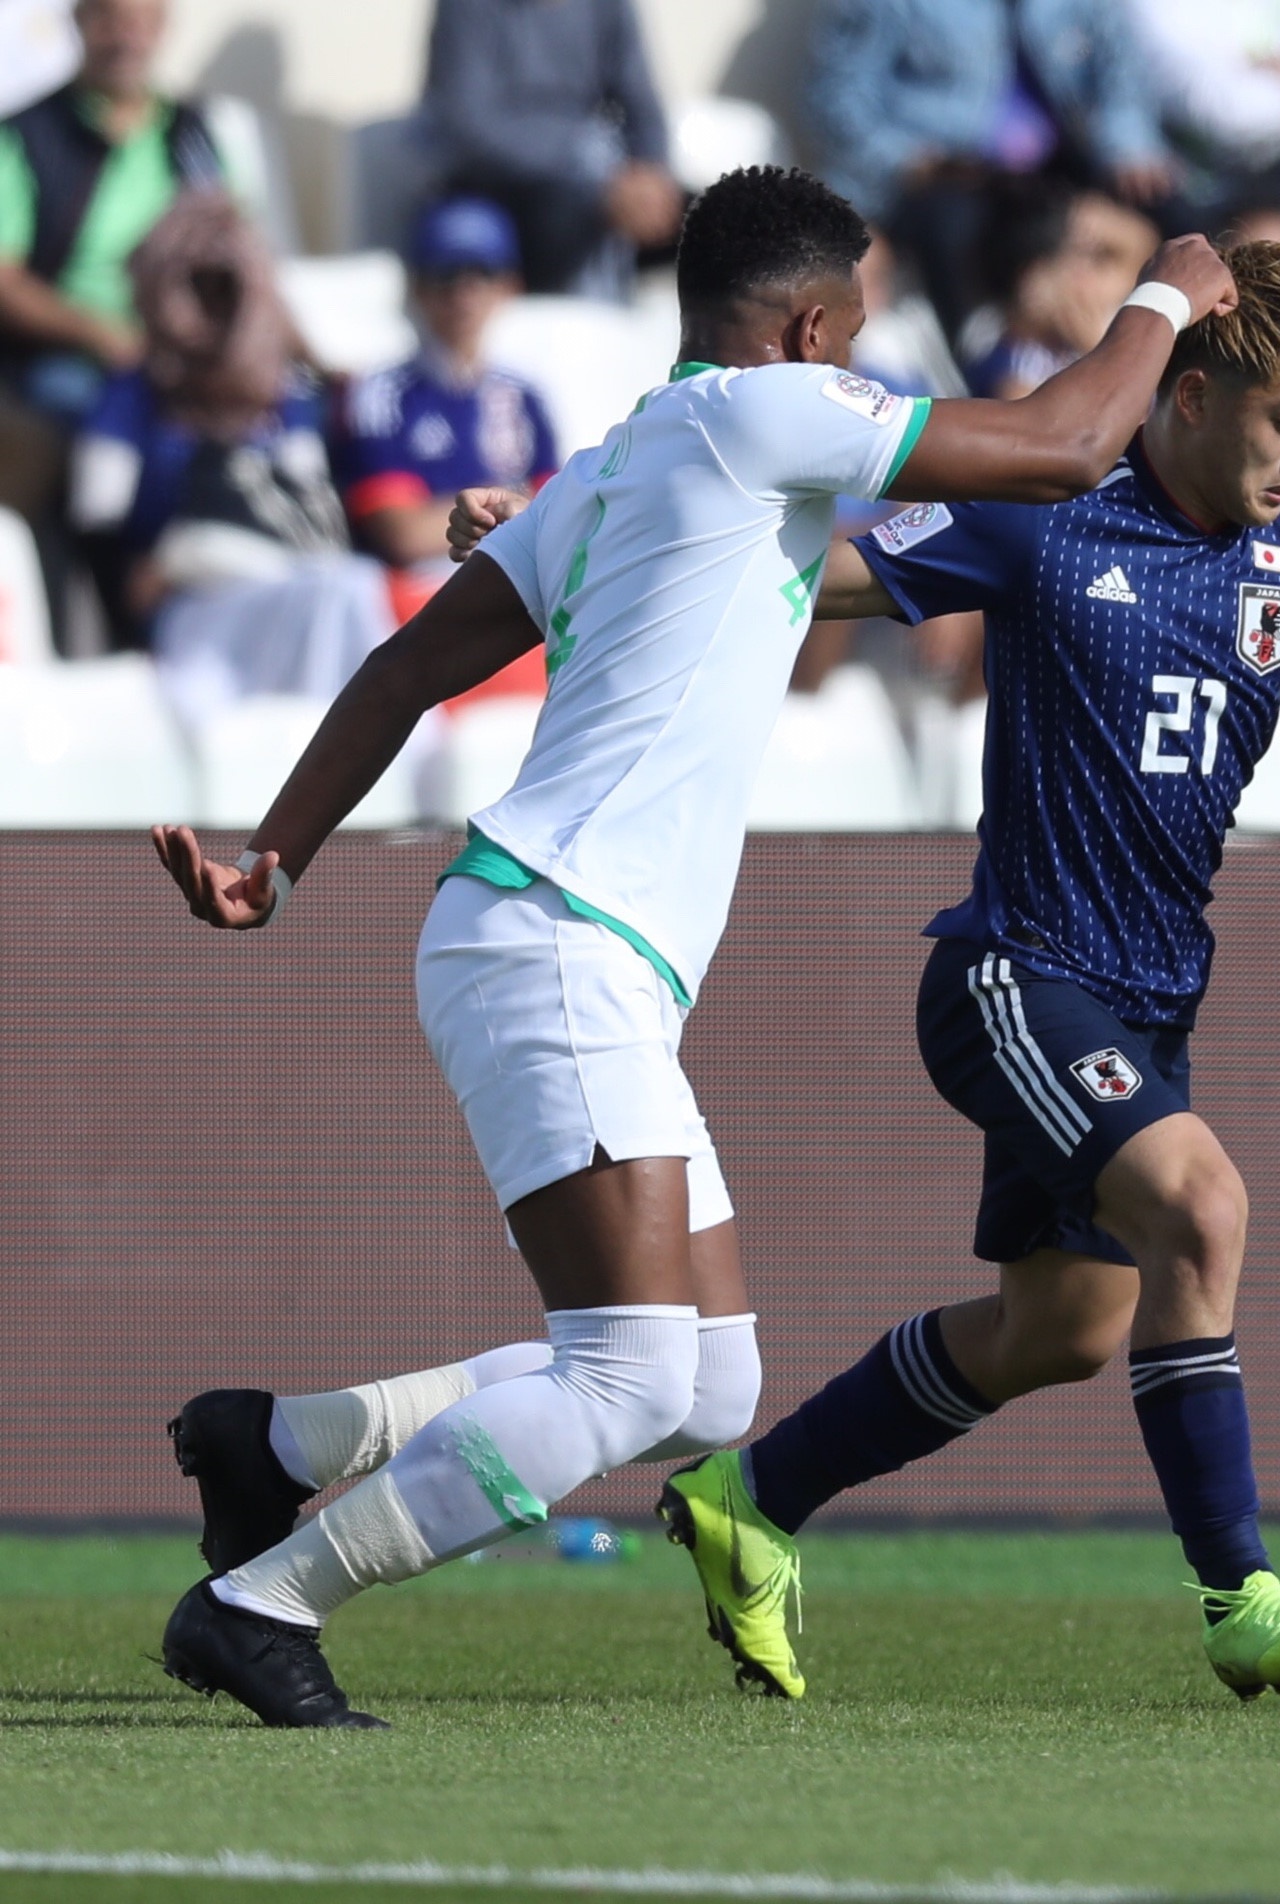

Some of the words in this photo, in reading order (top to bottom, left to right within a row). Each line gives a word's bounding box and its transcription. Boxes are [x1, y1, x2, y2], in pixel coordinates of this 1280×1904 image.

[778, 548, 828, 627] 4
[1086, 584, 1137, 604] adidas
[1140, 675, 1228, 776] 21
